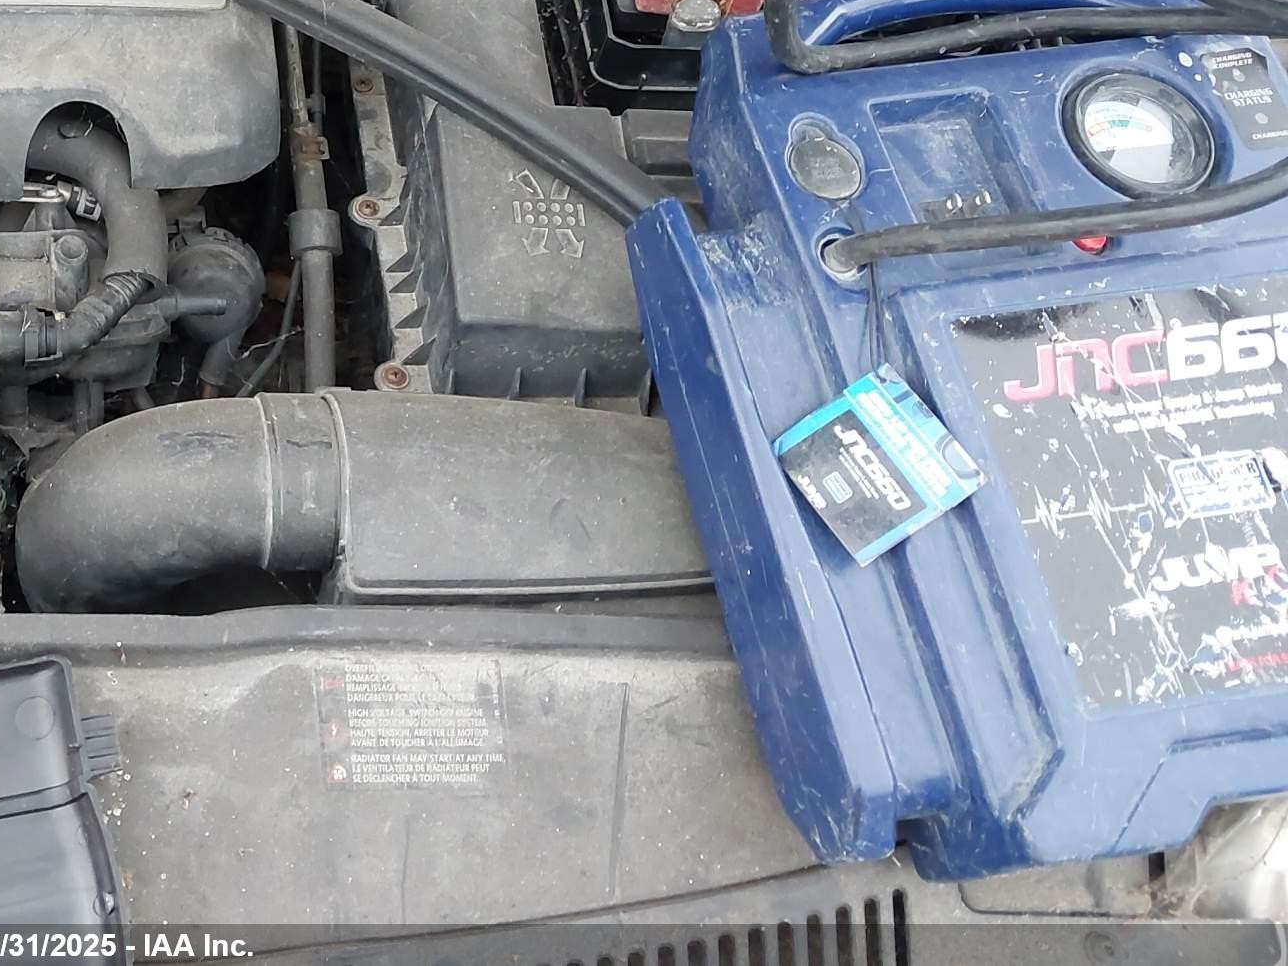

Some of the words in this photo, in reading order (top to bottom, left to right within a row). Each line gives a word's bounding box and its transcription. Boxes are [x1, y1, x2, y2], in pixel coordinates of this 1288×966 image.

[1223, 88, 1273, 100] CHARGING
[1233, 96, 1272, 107] STATUS
[1003, 310, 1288, 402] JNC66
[348, 708, 369, 717] HIGH
[350, 728, 375, 737] HAUTE
[457, 728, 489, 737] MOTEUR
[351, 738, 376, 747] AVANT
[380, 738, 388, 747] DE
[391, 738, 425, 747] TOUCHER
[351, 754, 390, 763] RADIATOR
[393, 754, 408, 763] FAN
[410, 754, 428, 763] MAY
[430, 754, 453, 763] START
[456, 754, 465, 763] AT
[467, 754, 483, 763] ANY
[352, 764, 361, 773] LE
[363, 764, 413, 773] VENTILATEUR
[415, 764, 425, 773] DE
[427, 764, 470, 773] RADIATEUR
[471, 764, 490, 773] PEUT
[353, 774, 361, 783] SE
[420, 774, 440, 783] TOUT
